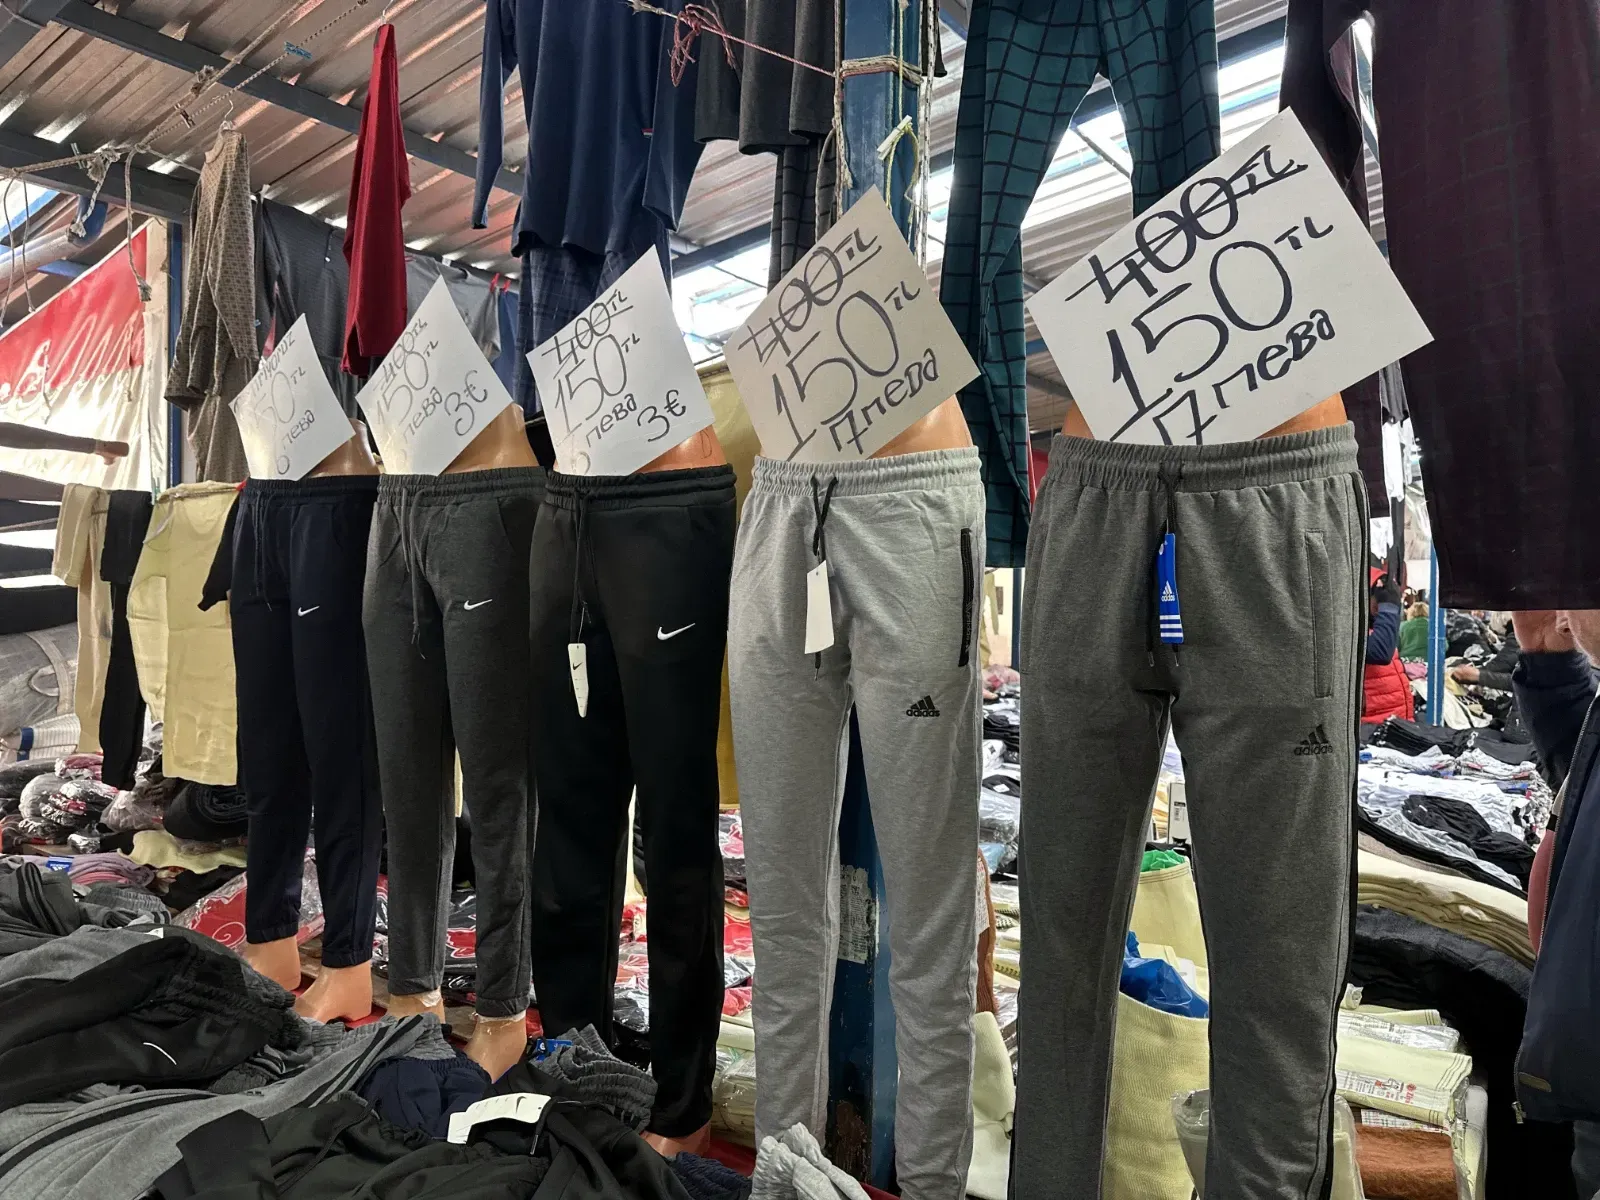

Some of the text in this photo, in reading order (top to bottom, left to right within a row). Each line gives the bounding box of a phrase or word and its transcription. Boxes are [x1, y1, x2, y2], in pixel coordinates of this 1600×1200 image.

[772, 290, 899, 461] 150
[1106, 240, 1292, 442] 150
[1293, 743, 1334, 756] adidas
